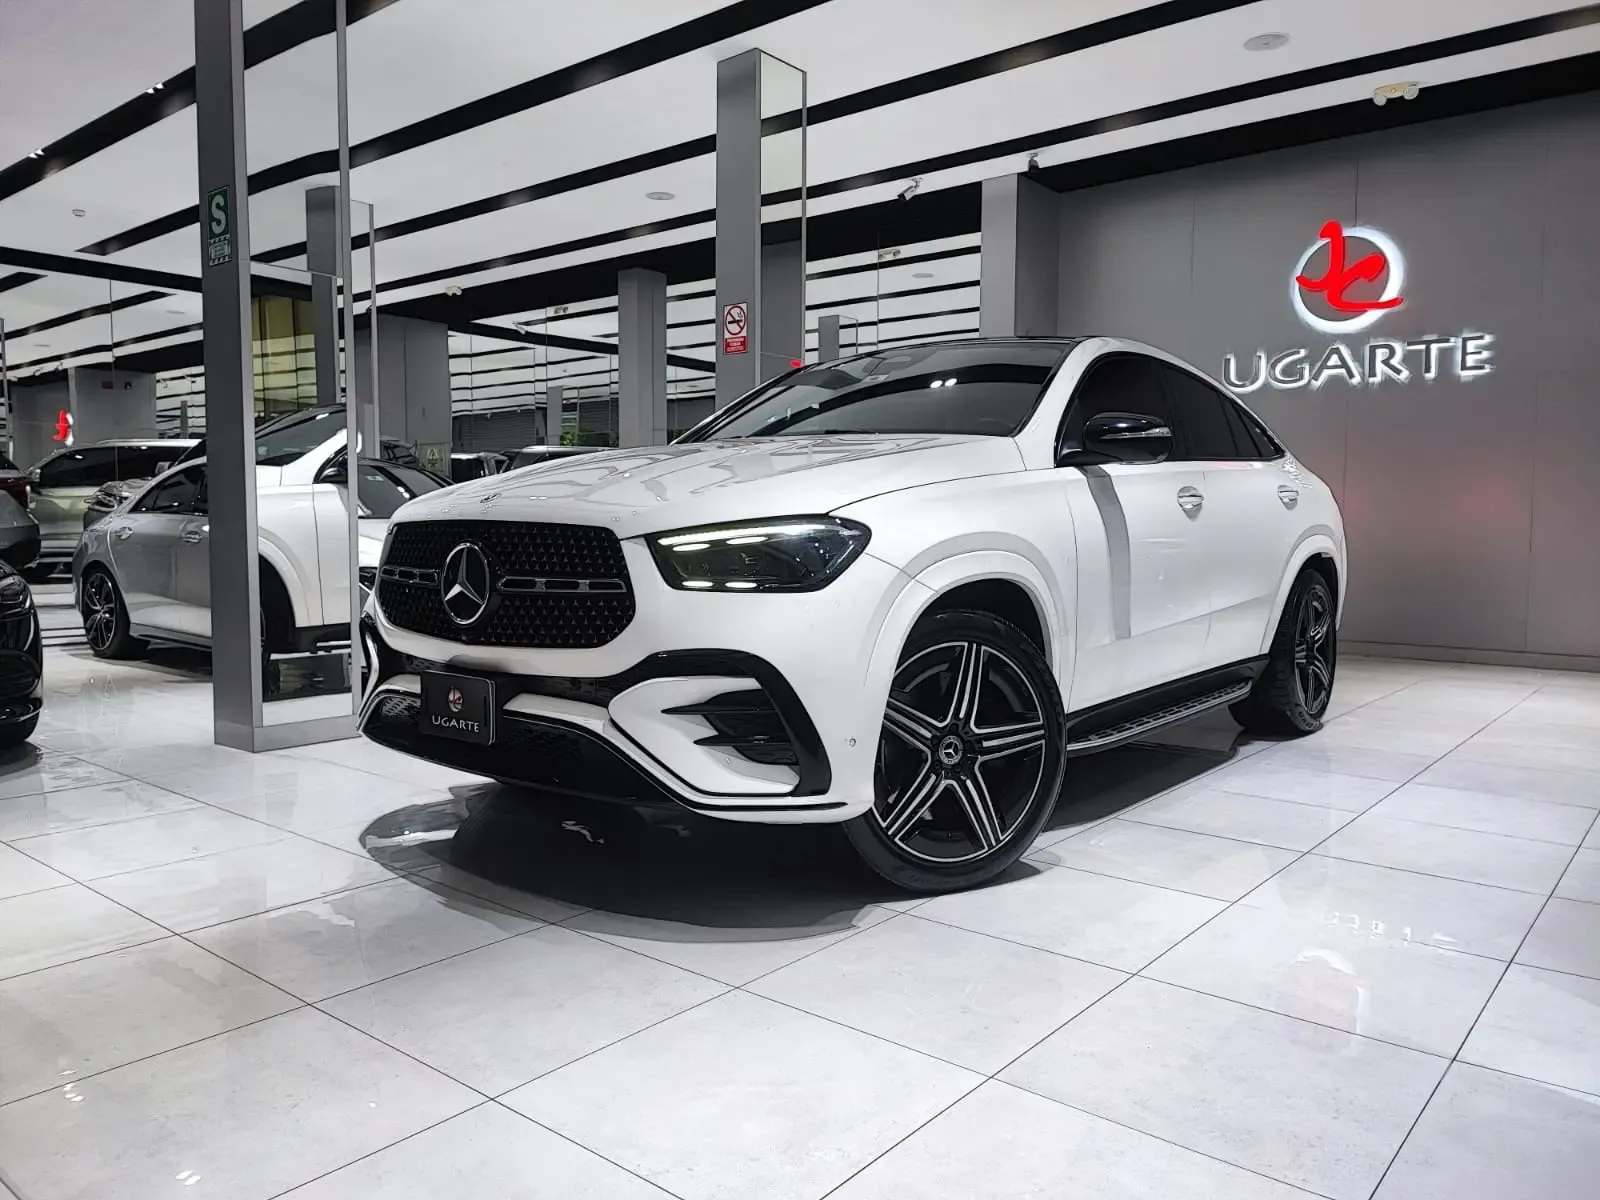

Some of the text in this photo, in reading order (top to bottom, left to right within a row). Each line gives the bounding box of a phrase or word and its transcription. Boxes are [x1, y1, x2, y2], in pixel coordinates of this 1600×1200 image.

[211, 194, 226, 234] S
[1223, 332, 1494, 394] UGARTE
[432, 714, 480, 733] UGARTE
